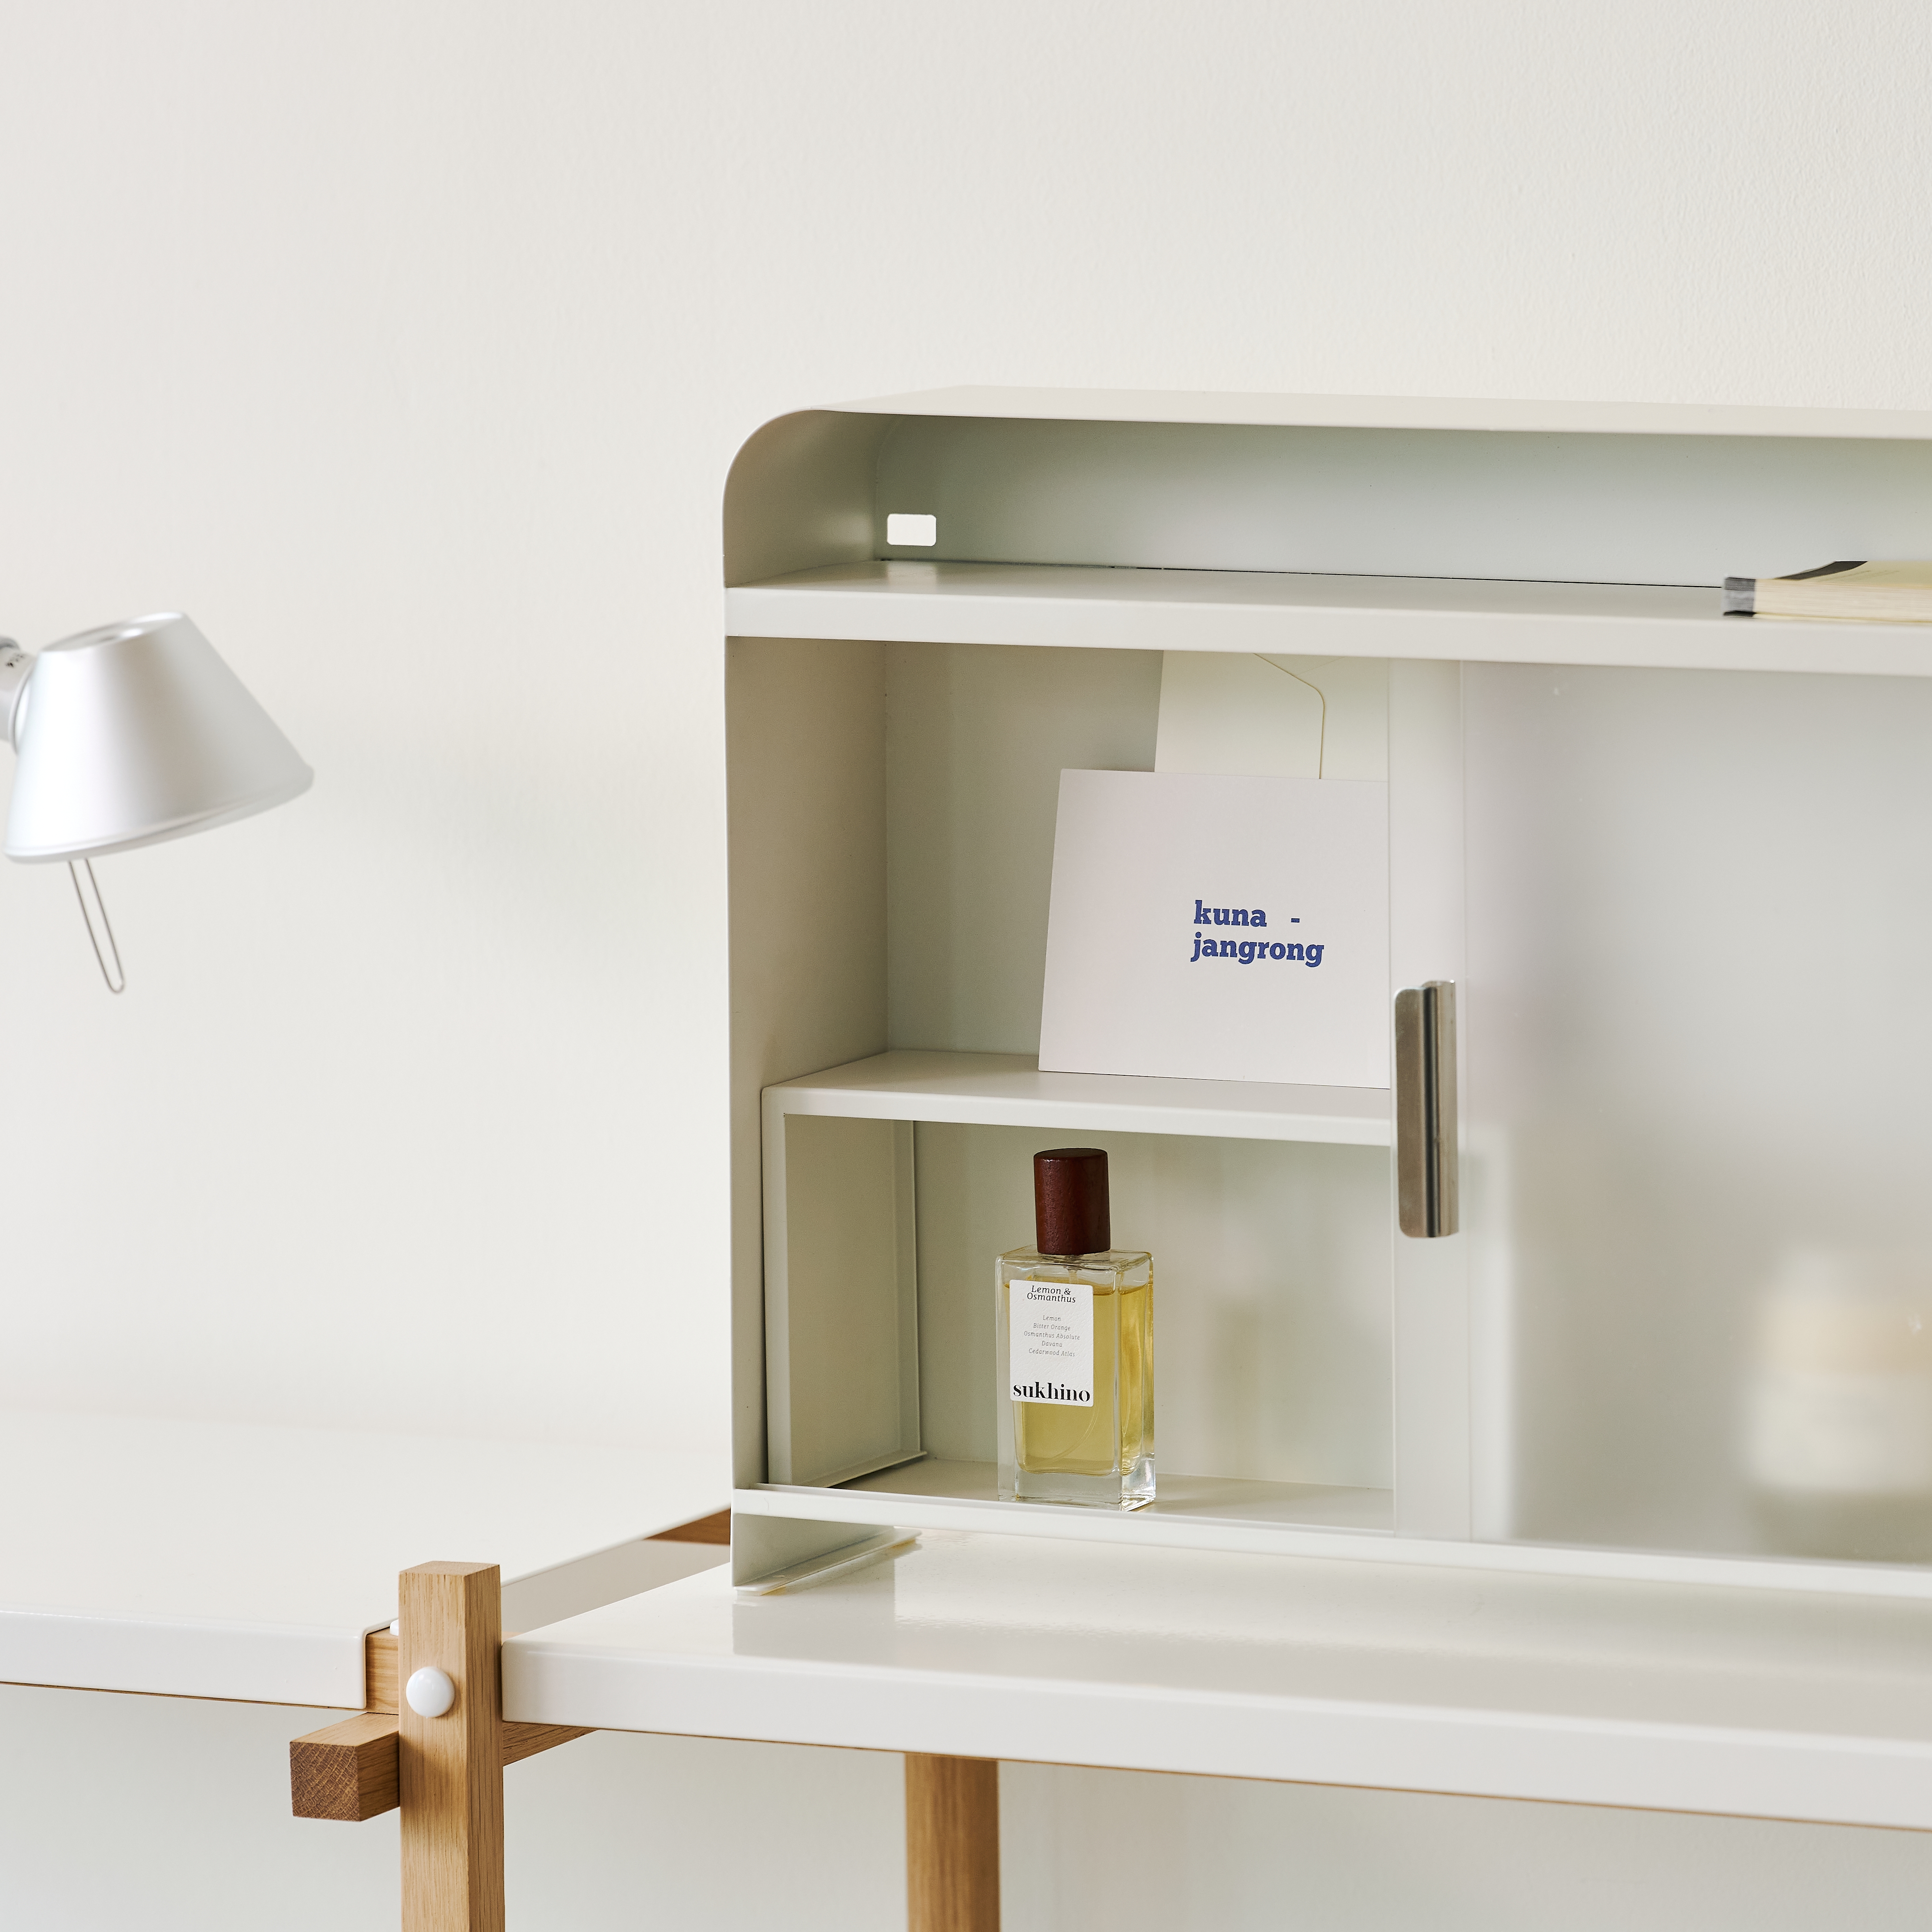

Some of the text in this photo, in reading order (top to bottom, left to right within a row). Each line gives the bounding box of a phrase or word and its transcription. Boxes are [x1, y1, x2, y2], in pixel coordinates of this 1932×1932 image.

[1194, 900, 1267, 927] kuna
[1190, 931, 1324, 968] jangrong
[1027, 1292, 1076, 1303] Osmanthus
[1031, 1285, 1061, 1294] Lemon
[1013, 1382, 1090, 1402] sukhino
